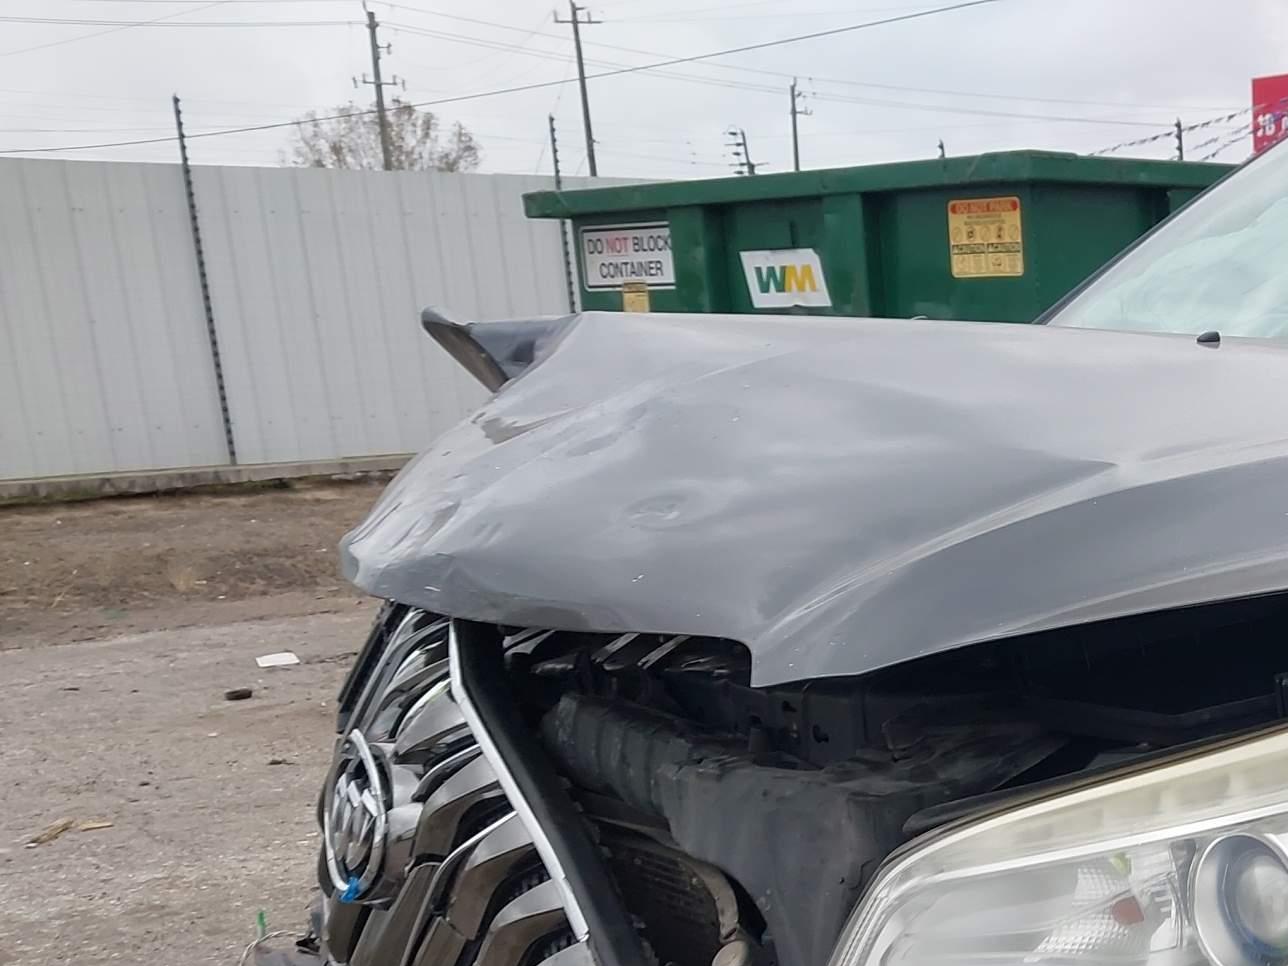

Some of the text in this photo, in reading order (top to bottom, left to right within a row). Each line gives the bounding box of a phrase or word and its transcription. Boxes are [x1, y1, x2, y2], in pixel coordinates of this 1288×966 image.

[587, 235, 672, 254] DO NOT BLOCK
[600, 260, 664, 278] CONTAINER
[754, 264, 817, 293] WM
